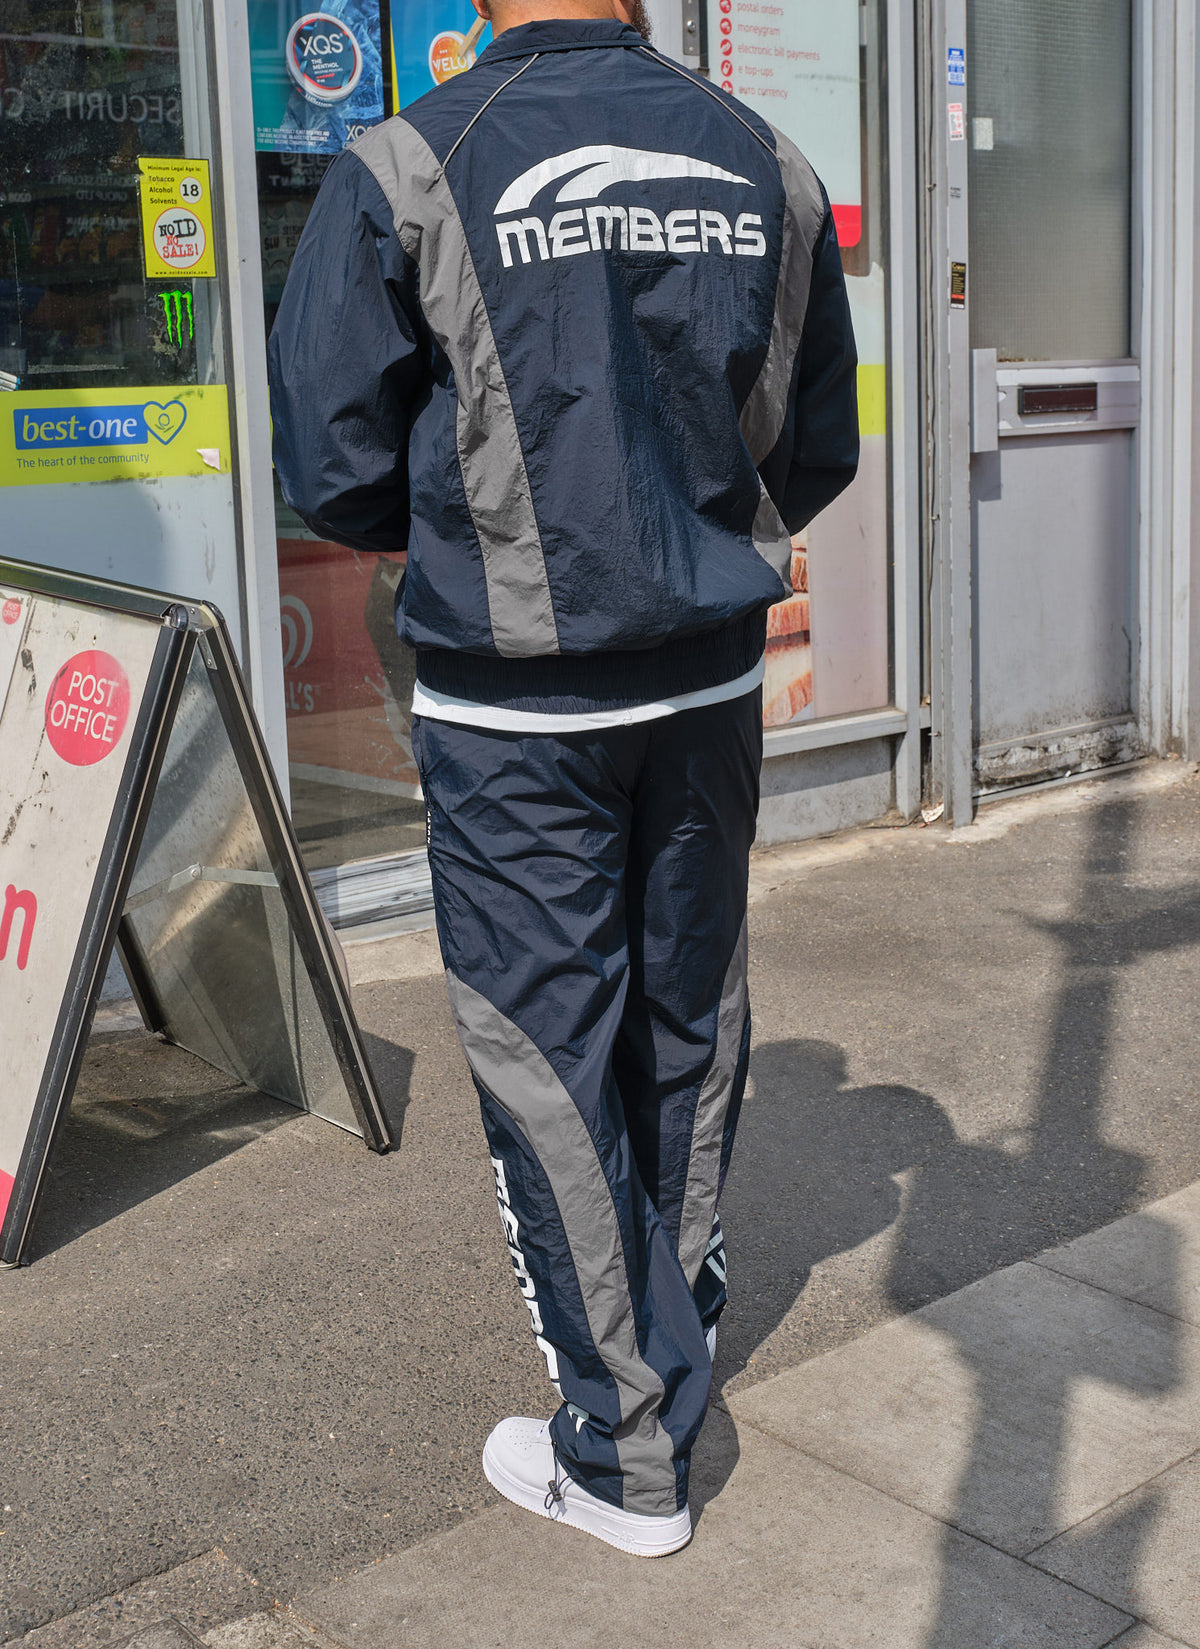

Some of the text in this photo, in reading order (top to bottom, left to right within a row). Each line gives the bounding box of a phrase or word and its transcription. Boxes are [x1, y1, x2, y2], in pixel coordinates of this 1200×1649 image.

[737, 2, 784, 16] postal orders
[738, 24, 780, 37] moneygram
[300, 33, 344, 57] XQS
[786, 49, 821, 61] payments
[432, 56, 468, 73] VELO
[148, 175, 175, 183] Tobacco
[149, 186, 173, 194] Alcohol
[182, 184, 199, 197] 18
[150, 197, 177, 205] Solvents
[158, 218, 197, 238] NO ID
[166, 235, 179, 246] NO
[495, 205, 767, 268] MEMBERS
[162, 243, 199, 259] SALE!
[22, 414, 138, 442] best-one
[16, 453, 150, 469] The heart of the community
[68, 671, 119, 707] POST
[51, 700, 117, 743] OFFICE
